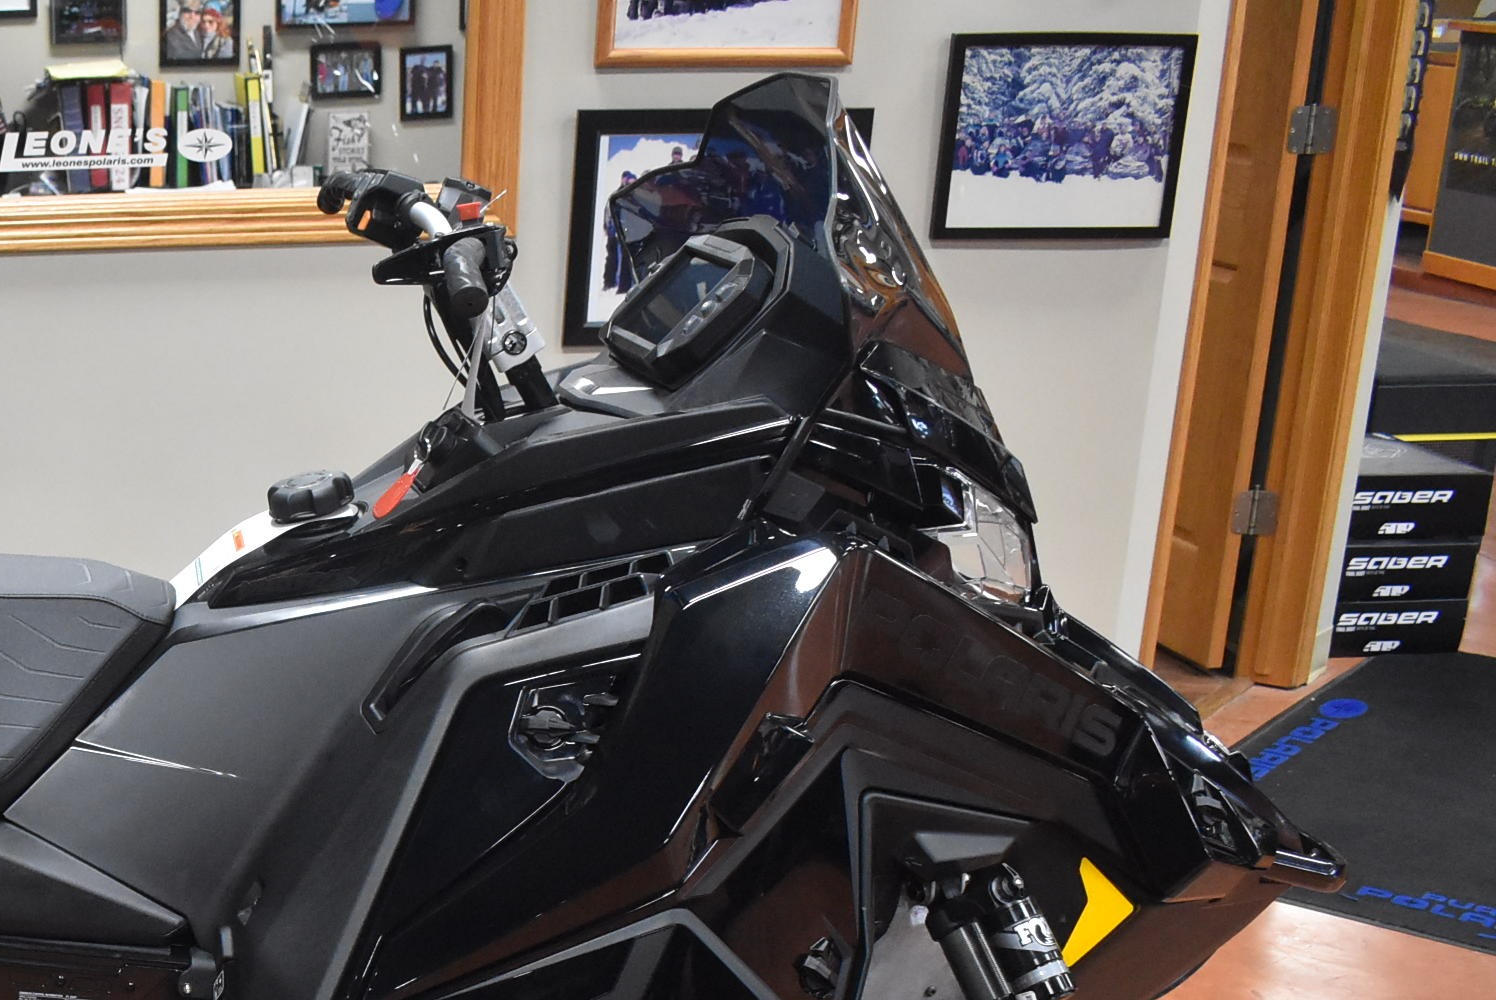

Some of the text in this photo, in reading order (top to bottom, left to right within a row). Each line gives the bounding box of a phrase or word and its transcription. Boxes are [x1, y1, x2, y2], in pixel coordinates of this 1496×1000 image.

[0, 127, 169, 172] LEONE'S
[21, 157, 154, 169] www.leonespolaris.com
[1353, 490, 1454, 505] SABER
[1347, 556, 1449, 571] SABER
[1336, 611, 1440, 626] SABER
[1356, 885, 1496, 929] POLA
